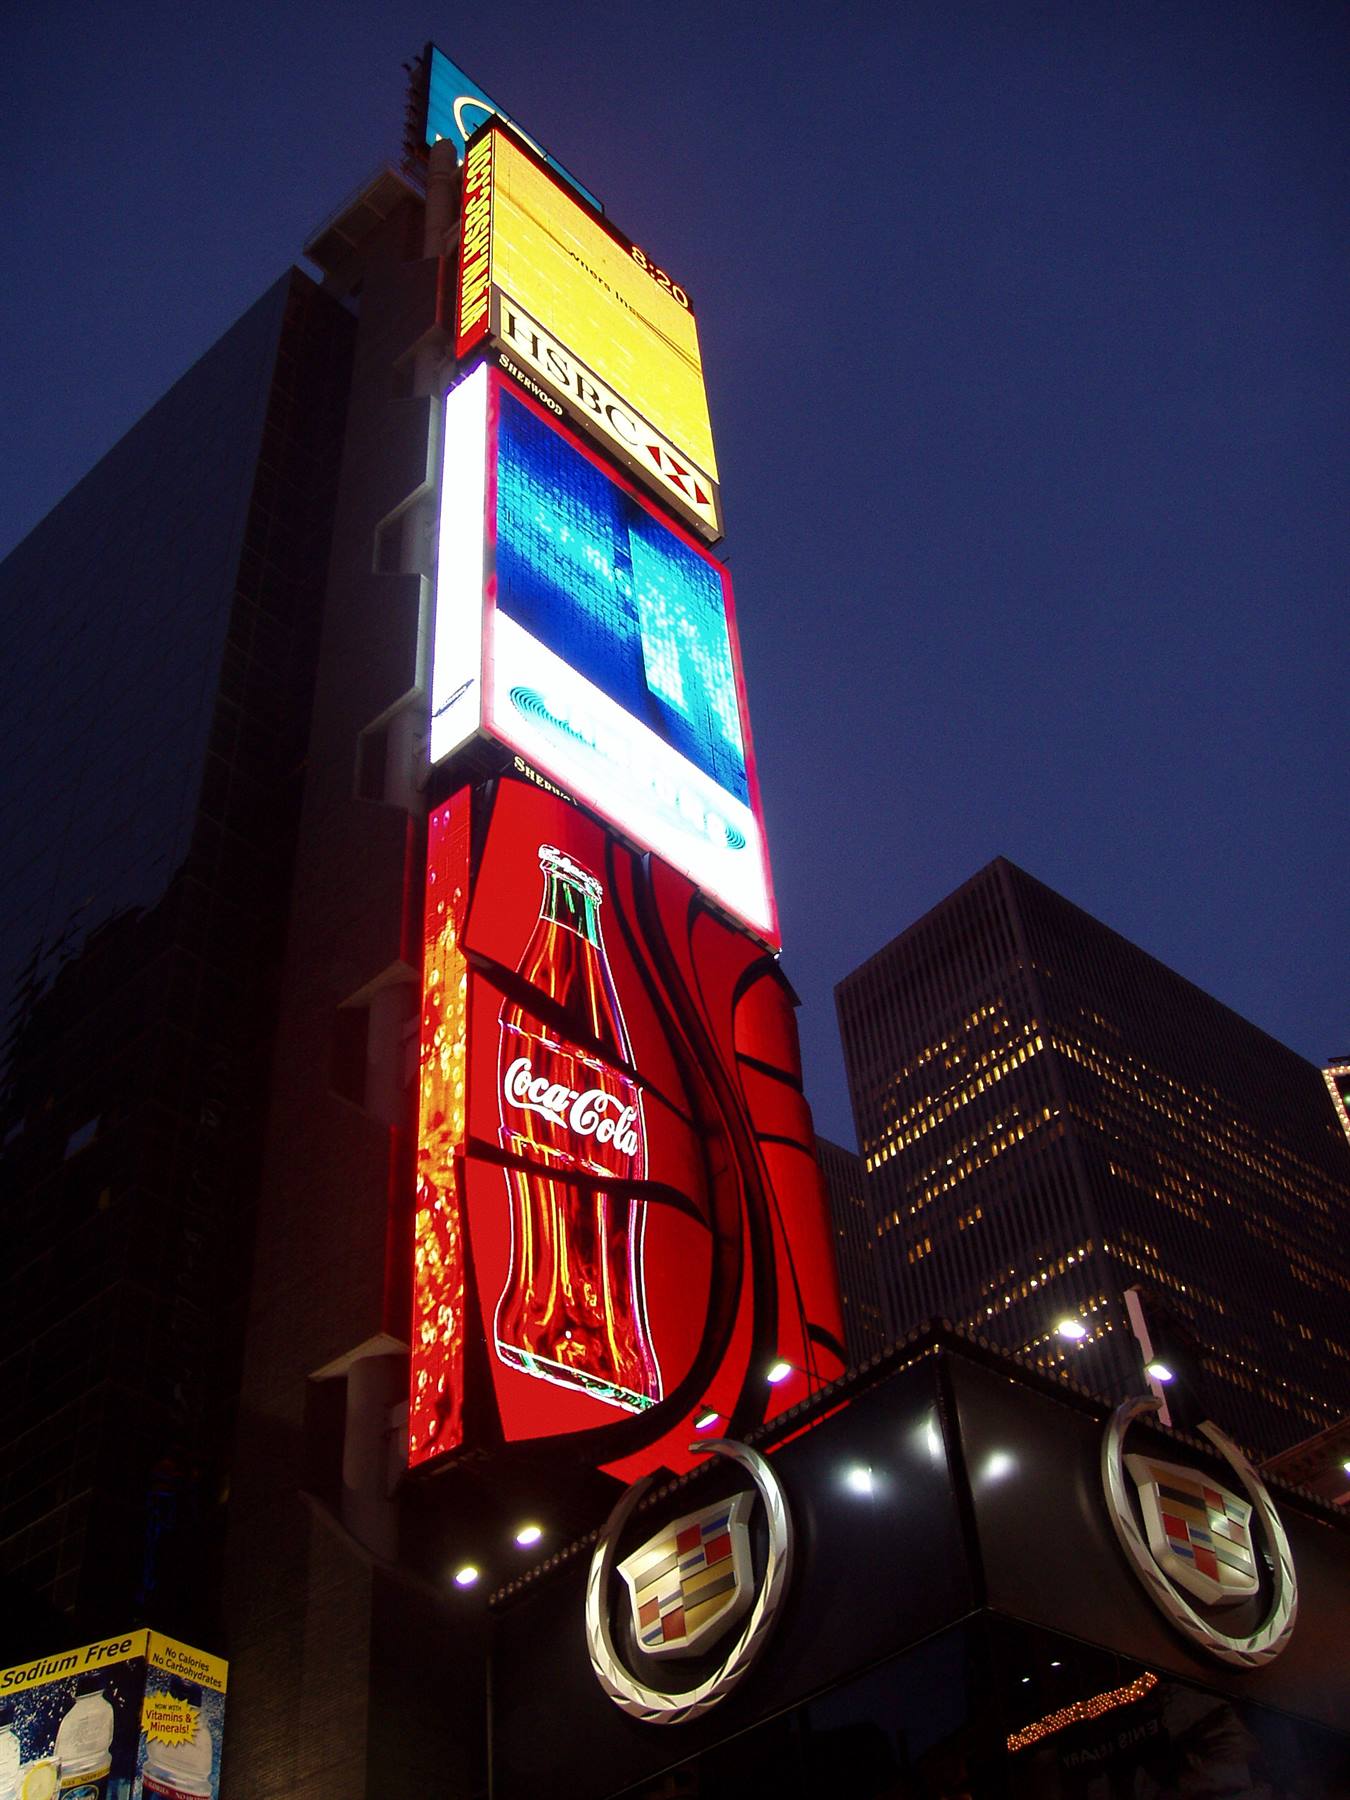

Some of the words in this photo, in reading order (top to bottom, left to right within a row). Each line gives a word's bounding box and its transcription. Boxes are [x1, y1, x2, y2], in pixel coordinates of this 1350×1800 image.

[460, 131, 492, 337] WWW.HSBC.COM
[631, 246, 688, 308] 8:20
[499, 353, 563, 416] SHERWOOD
[502, 305, 638, 446] HSBC
[504, 1057, 638, 1157] Coca-Cola
[1, 1655, 78, 1689] Sodium
[85, 1638, 132, 1664] Free
[152, 1653, 164, 1665] No
[165, 1659, 222, 1688] Carbohydrates
[165, 1647, 177, 1658] No
[178, 1652, 209, 1672] Calories
[146, 1709, 183, 1723] Vitamins
[185, 1713, 192, 1723] &
[151, 1722, 190, 1734] Minerals!
